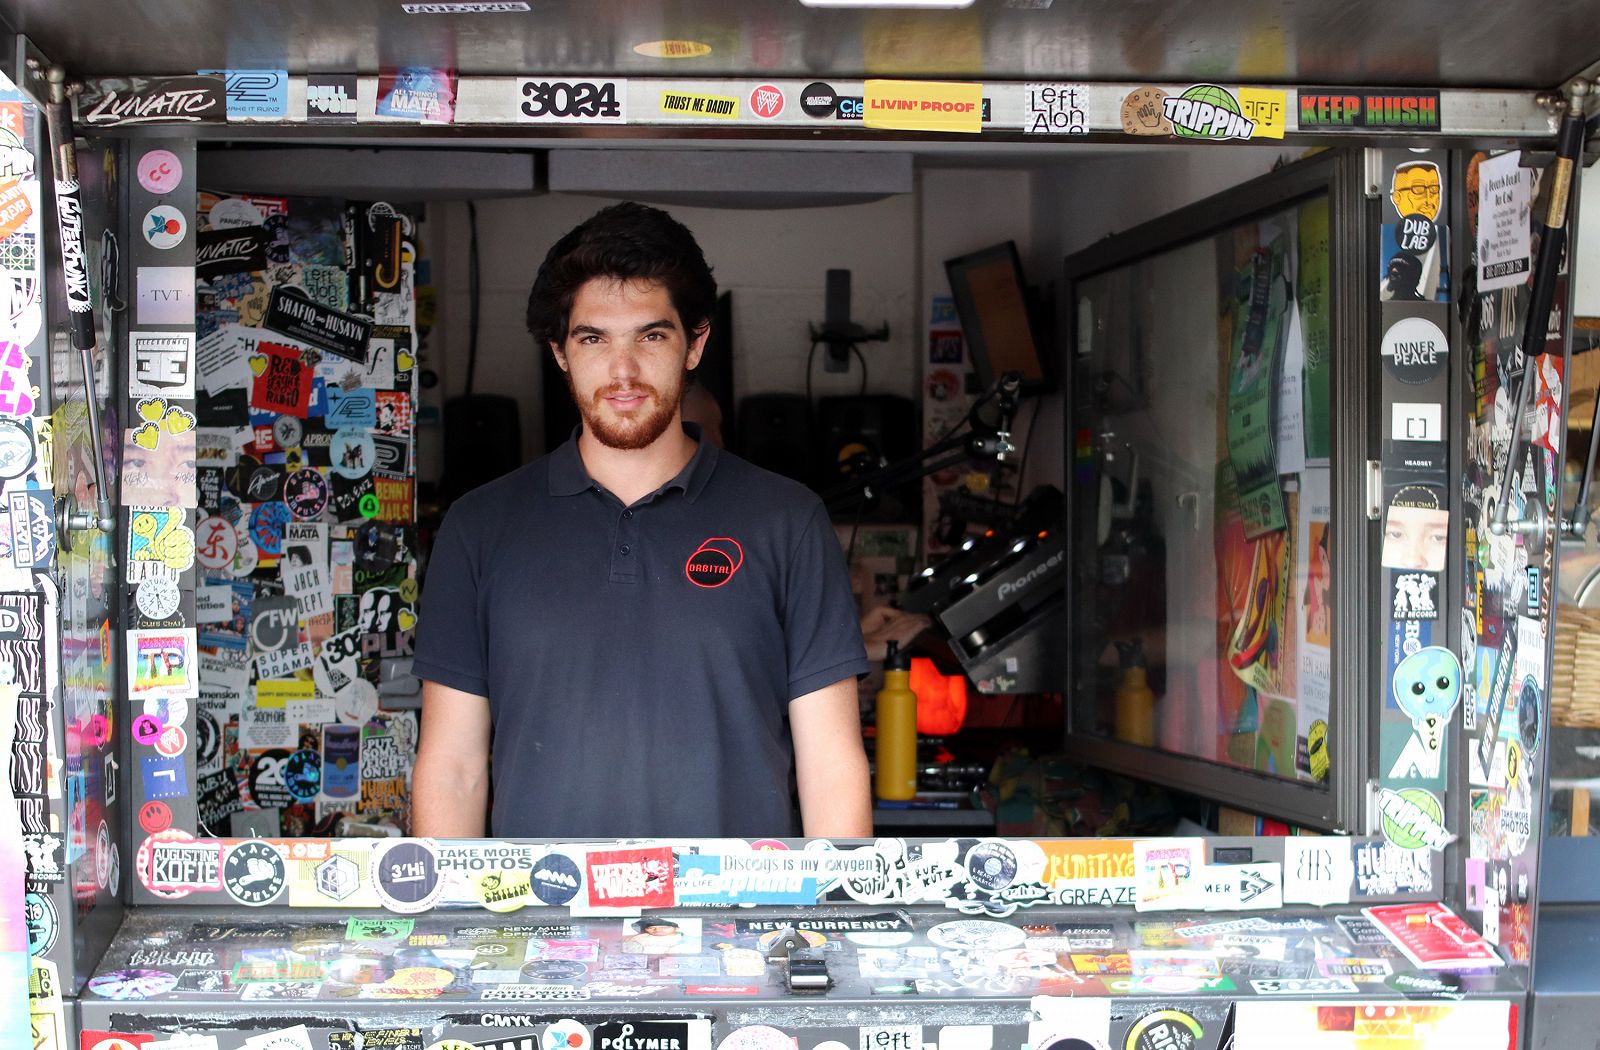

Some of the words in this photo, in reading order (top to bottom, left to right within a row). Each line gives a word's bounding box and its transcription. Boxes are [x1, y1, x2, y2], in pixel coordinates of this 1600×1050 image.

[86, 89, 216, 123] LUNATIC
[391, 95, 441, 112] MATA
[521, 82, 621, 117] 3024
[663, 95, 691, 111] TRUST
[692, 97, 706, 112] ME
[707, 99, 735, 115] DADDY
[921, 101, 975, 112] PROOF
[1031, 86, 1078, 112] Left
[1165, 98, 1255, 138] TRIPPIN
[1302, 96, 1360, 126] KEEP
[1365, 96, 1437, 126] HUSH
[1403, 218, 1430, 235] DUB
[1401, 236, 1428, 250] LAB
[151, 289, 183, 301] TVT
[277, 296, 316, 326] SHAFIQ
[325, 314, 365, 341] HUSAYN
[1394, 341, 1435, 354] INNER
[1394, 352, 1437, 366] PEACE
[289, 529, 320, 539] MATA
[689, 564, 729, 575] ORBITAL
[997, 550, 1064, 600] Pioneer
[259, 644, 310, 666] SUPER
[261, 657, 313, 679] DRAMA
[367, 738, 393, 749] PUT
[1501, 820, 1530, 836] PHOTOS
[153, 849, 218, 862] AUGUSTINE
[229, 843, 280, 866] BLACK
[438, 849, 478, 858] TAKE
[484, 848, 532, 857] MORE
[437, 857, 533, 870] PHOTOS
[724, 854, 778, 872] Discogs
[783, 854, 794, 870] is
[801, 858, 819, 872] my
[825, 857, 873, 872] oxygen
[153, 860, 219, 883] KOFIE
[915, 865, 939, 880] RUF
[229, 878, 282, 902] IMPULSE
[750, 921, 793, 930] NEW
[798, 919, 901, 930] CURRENCY
[481, 1013, 535, 1027] CMYK
[602, 1036, 681, 1050] POLYMER
